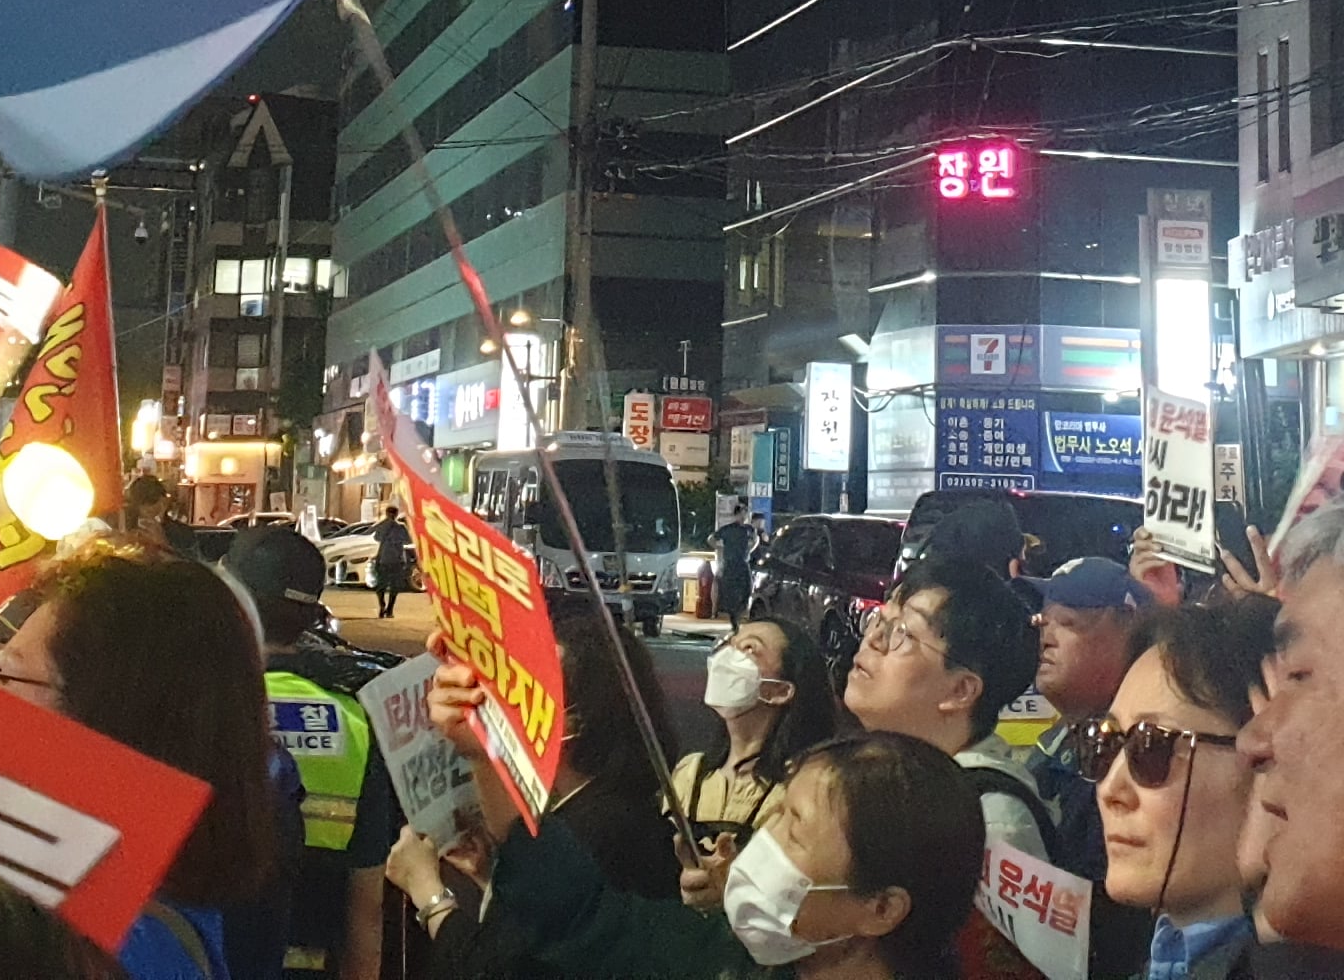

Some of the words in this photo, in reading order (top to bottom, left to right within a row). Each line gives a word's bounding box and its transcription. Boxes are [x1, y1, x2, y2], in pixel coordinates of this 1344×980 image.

[937, 147, 1016, 199] 장원
[629, 401, 651, 445] 도장
[1054, 435, 1091, 455] 법무사
[1095, 436, 1132, 457] 노오석
[1145, 475, 1207, 533] 하라!
[421, 497, 535, 611] 승리로
[997, 857, 1080, 937] 윤석열
